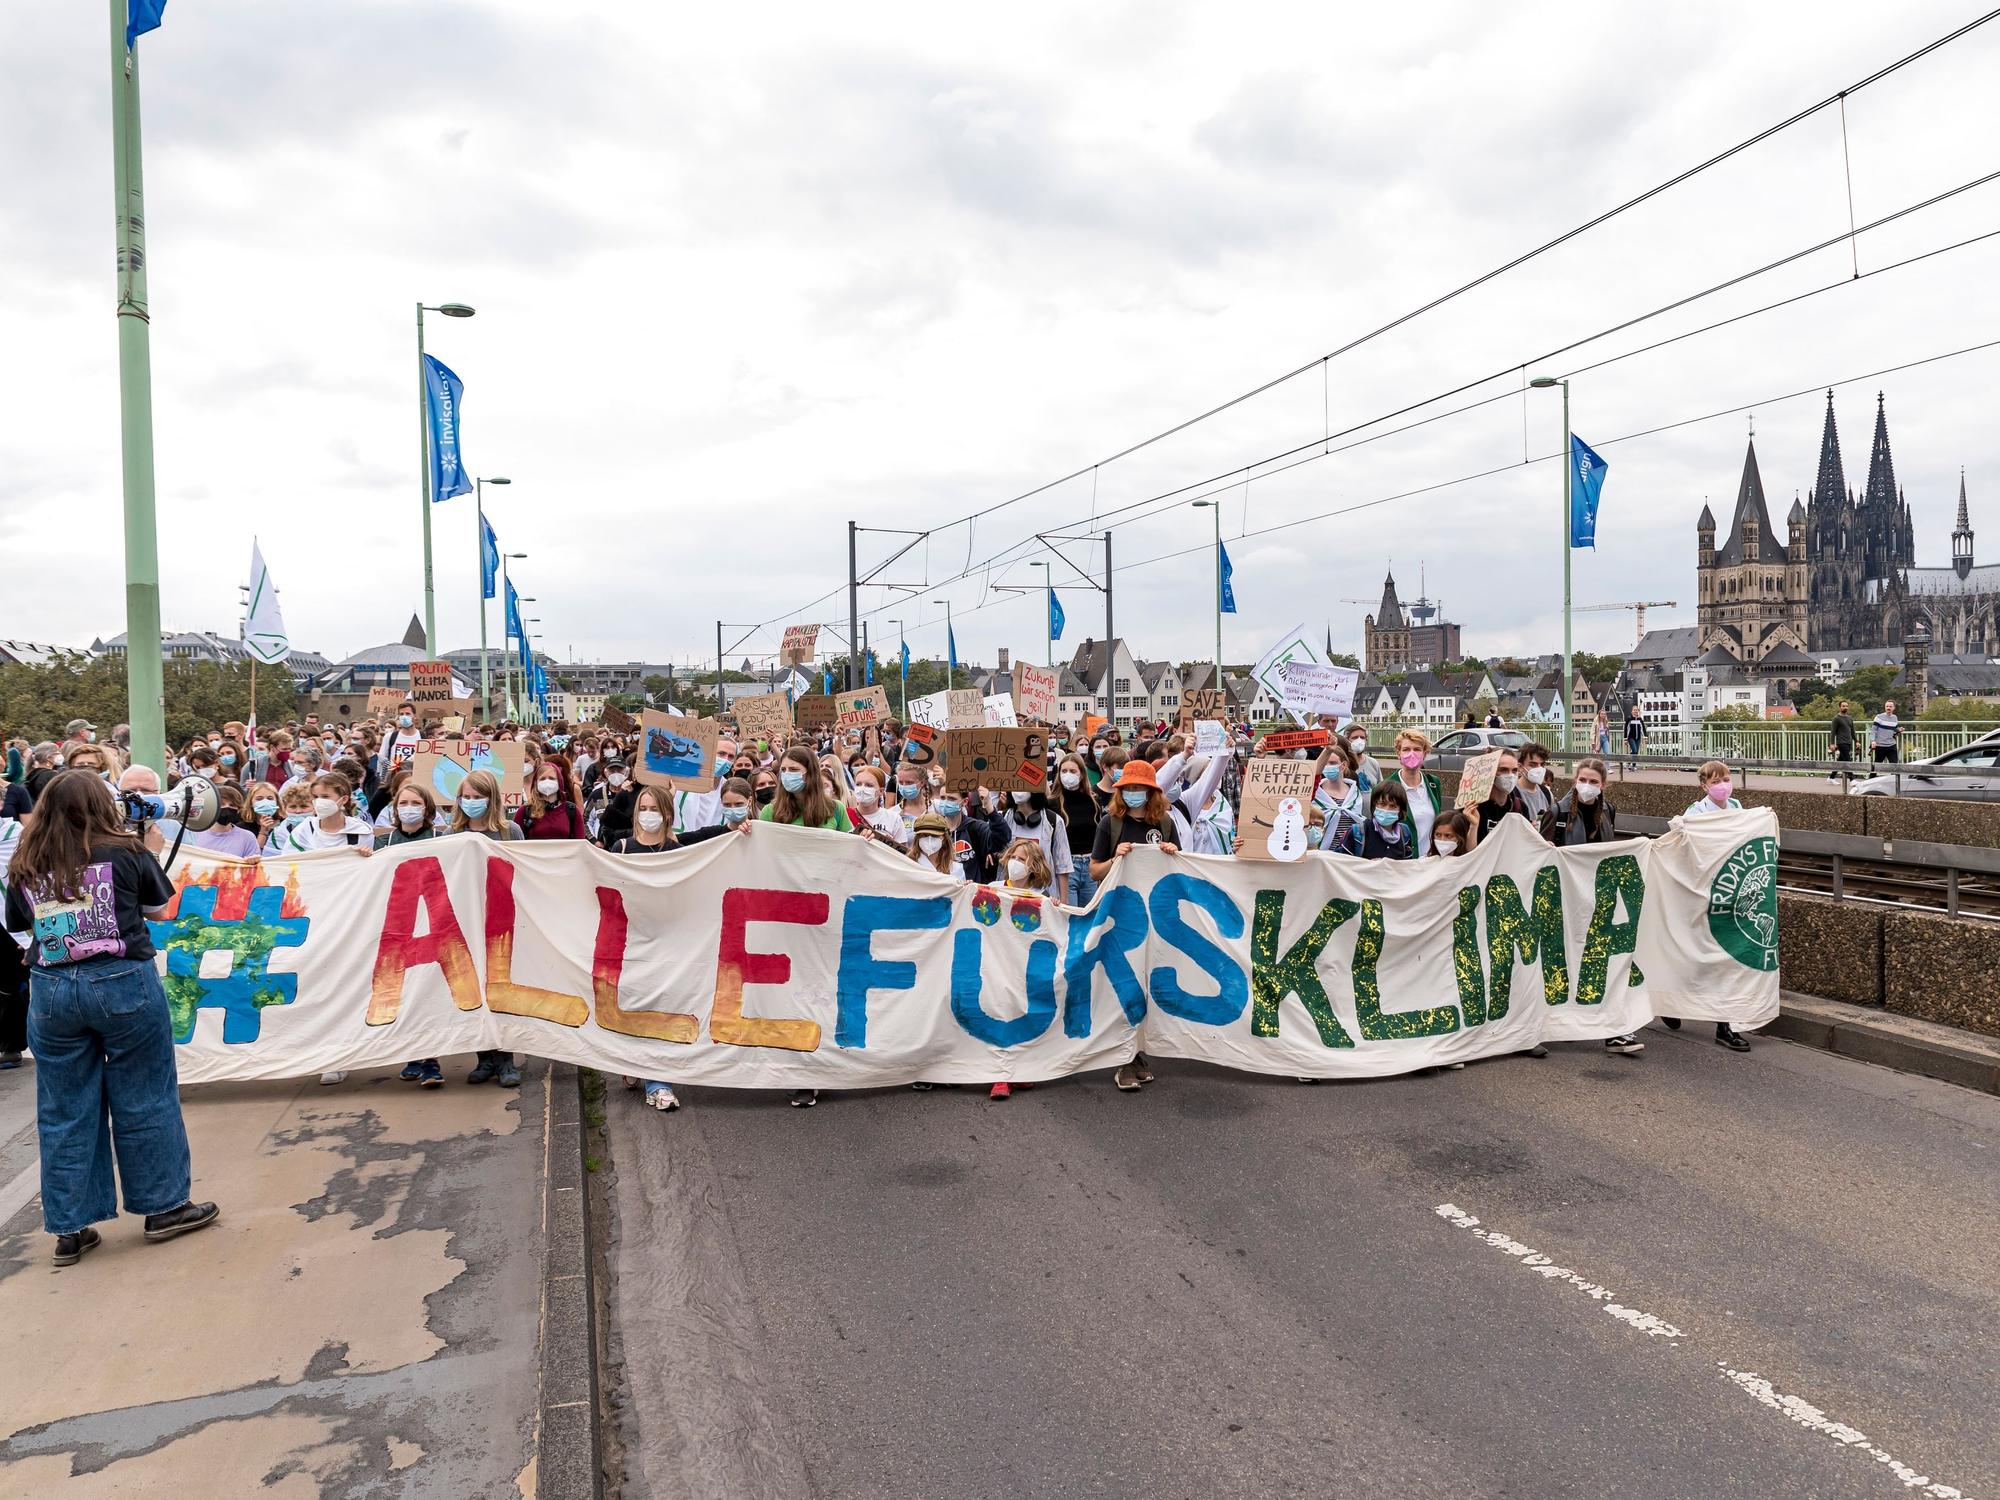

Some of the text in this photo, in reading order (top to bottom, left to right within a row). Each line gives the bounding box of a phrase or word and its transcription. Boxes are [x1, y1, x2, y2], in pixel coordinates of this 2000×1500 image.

[411, 663, 451, 674] POLITIK
[414, 676, 449, 687] KLIMA
[1024, 667, 1055, 689] Zukunft
[413, 689, 453, 702] WANDEL
[1183, 689, 1222, 709] SAVE
[912, 697, 933, 713] IT'S
[840, 708, 876, 724] FUTURE
[915, 711, 930, 723] MY
[1192, 708, 1213, 718] OUR
[743, 715, 764, 725] CDU
[416, 740, 490, 757] DIE UHR
[950, 731, 985, 756] Make
[992, 729, 1016, 756] the
[1251, 763, 1300, 774] HILFE!!!
[1251, 772, 1311, 784] RETTET
[1262, 785, 1312, 796] MICH!!!
[1711, 845, 1758, 915] FRIDAYS
